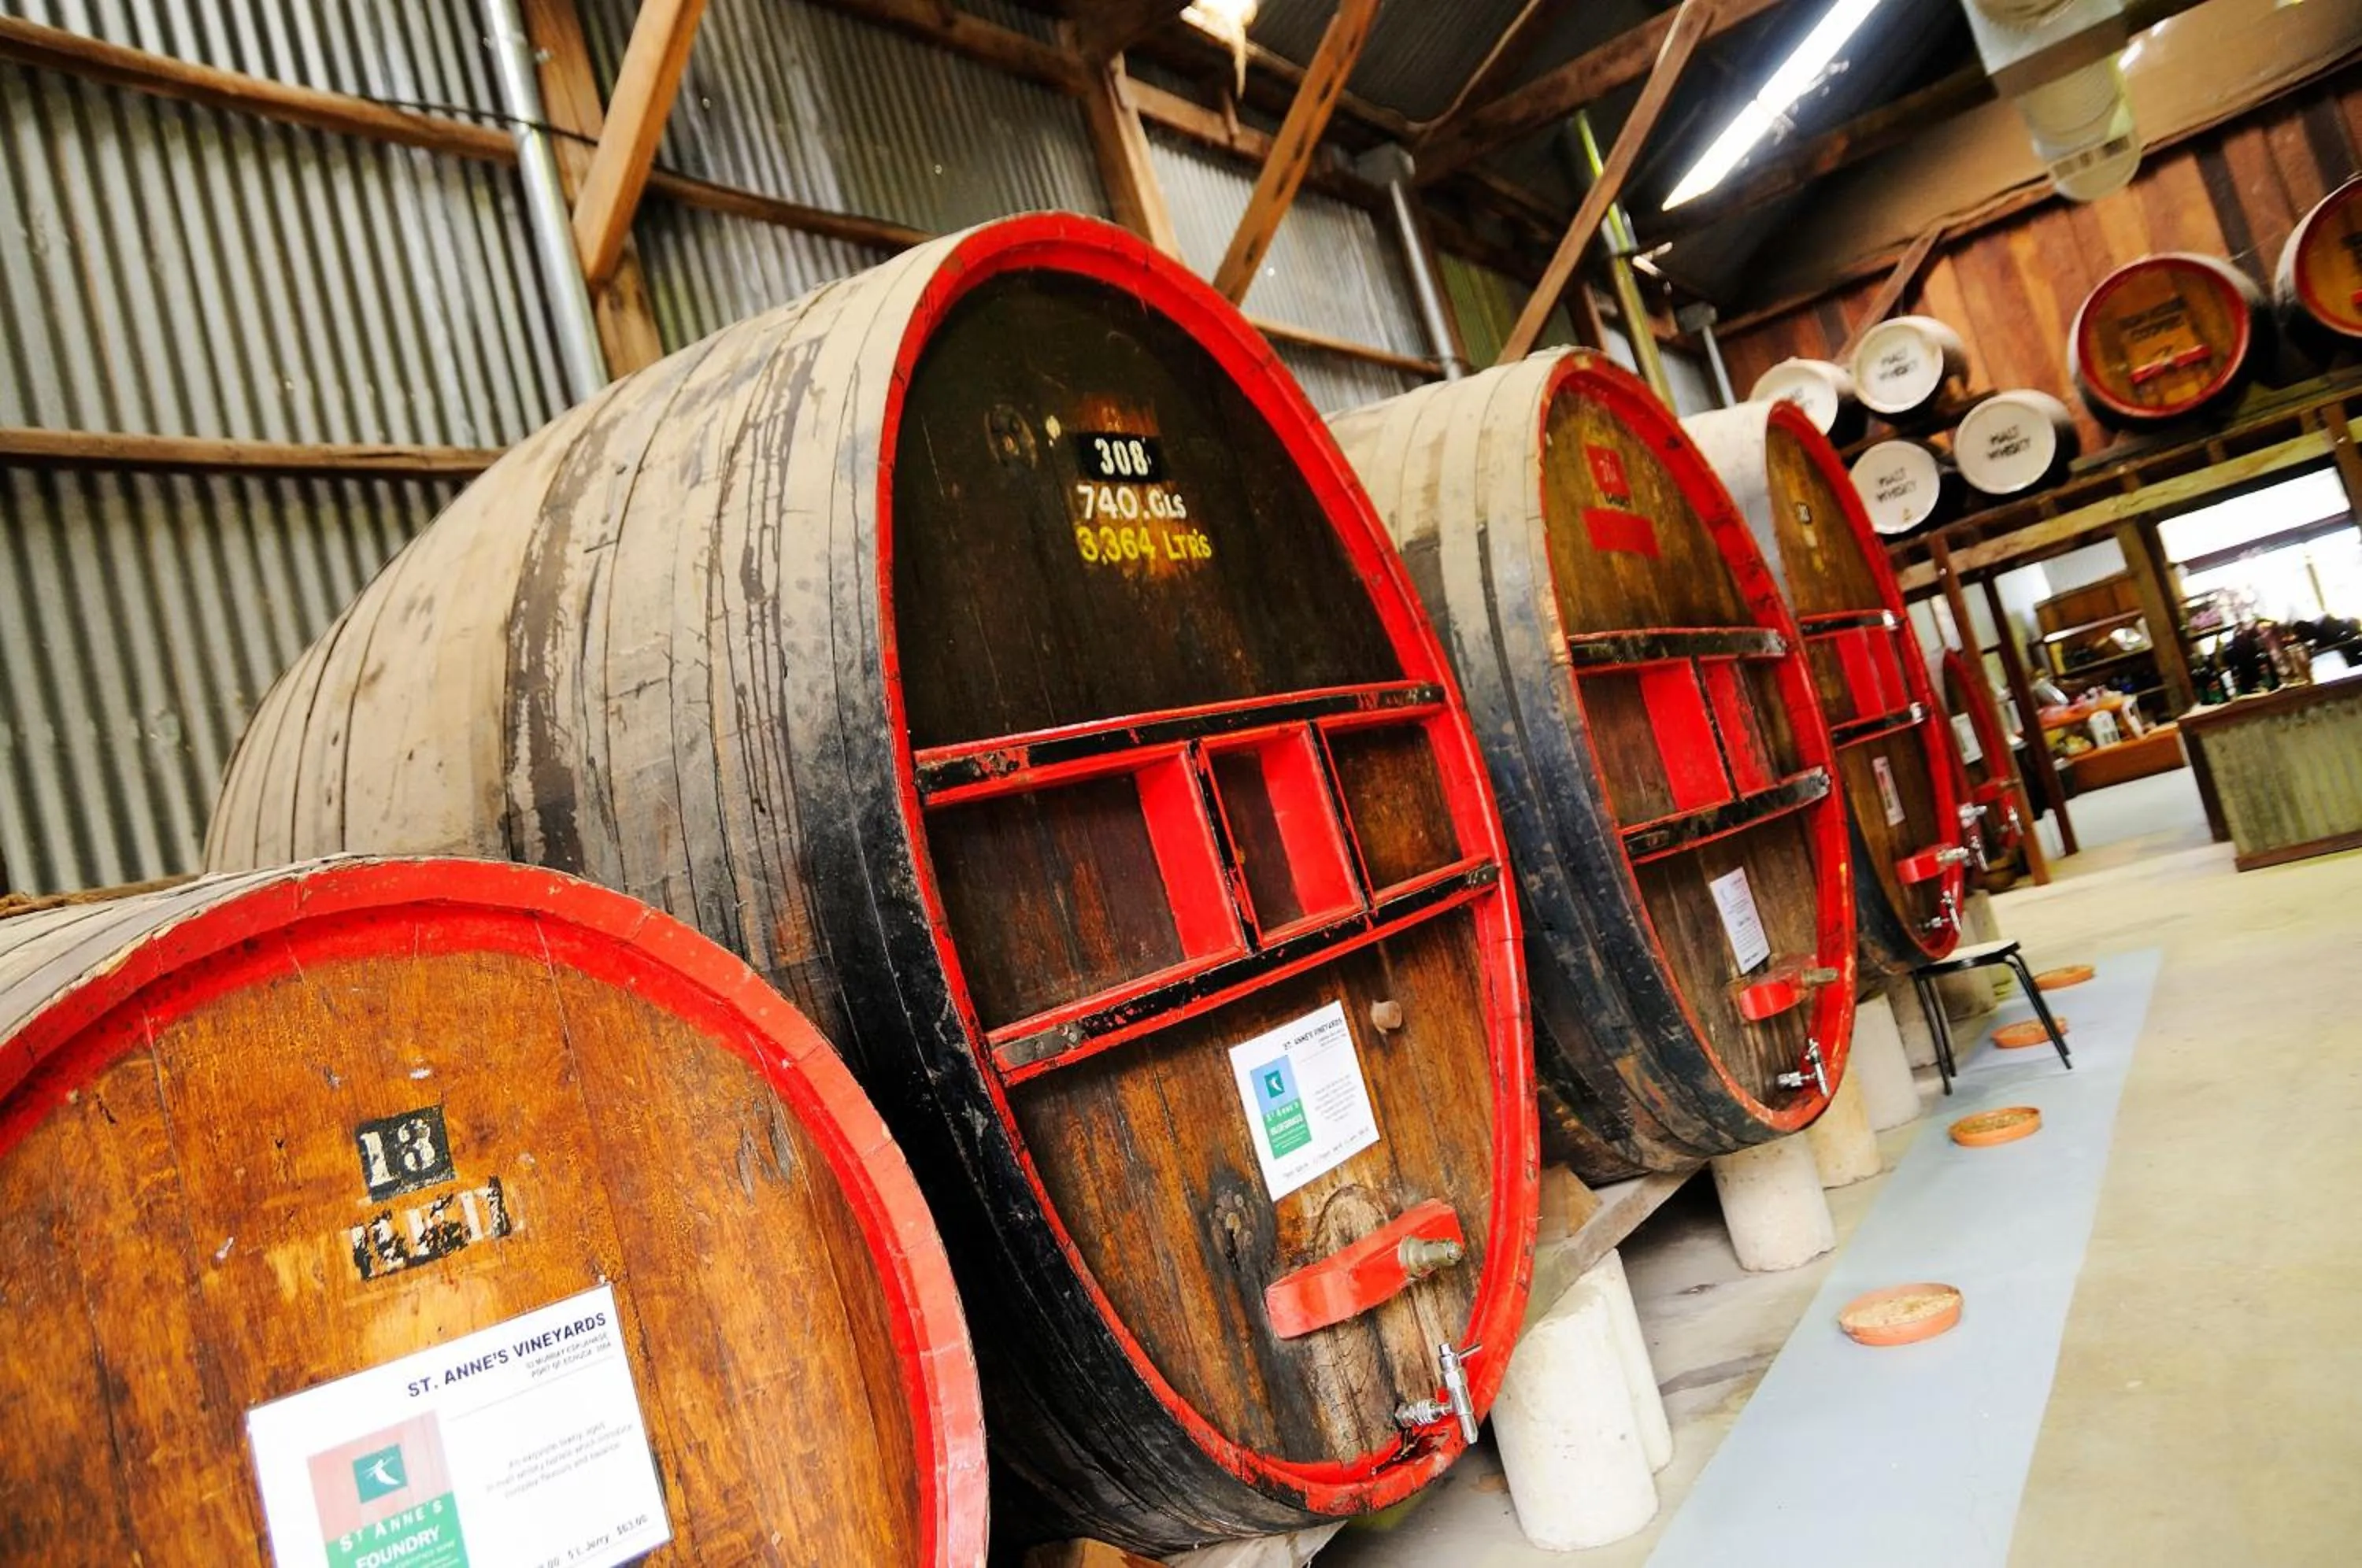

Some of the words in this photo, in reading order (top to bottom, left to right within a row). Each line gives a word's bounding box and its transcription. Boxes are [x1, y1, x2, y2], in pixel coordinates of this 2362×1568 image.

[1094, 438, 1149, 475] 308
[360, 1118, 436, 1188] 18
[406, 1376, 439, 1398] ST.
[444, 1348, 509, 1385] ANNE'S
[512, 1312, 606, 1357] VINEYARDS
[356, 1525, 440, 1568] FOUNDRY
